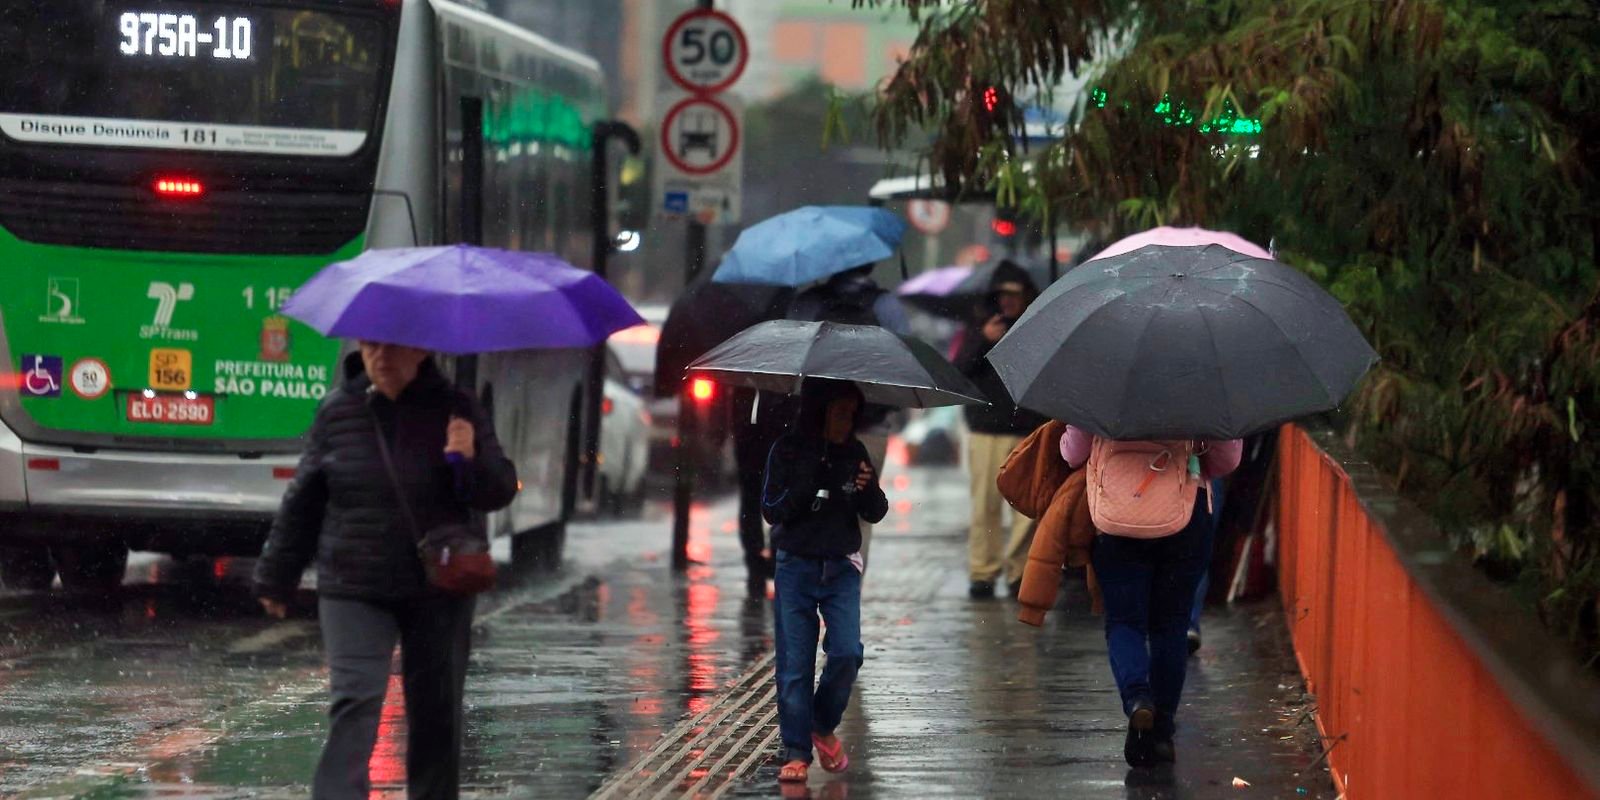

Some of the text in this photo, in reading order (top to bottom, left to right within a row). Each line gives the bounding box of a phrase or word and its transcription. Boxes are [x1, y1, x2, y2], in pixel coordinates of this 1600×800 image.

[119, 12, 251, 59] 975A-10
[681, 29, 735, 66] 50
[21, 120, 86, 136] Disque
[93, 124, 170, 139] Denúncia
[181, 128, 217, 145] 181
[139, 324, 199, 341] SPTrans
[155, 352, 178, 368] SP
[215, 359, 327, 381] PREFEITURA DE
[82, 370, 98, 384] 50
[154, 368, 186, 385] 156
[214, 375, 326, 400] SÃO PAULO
